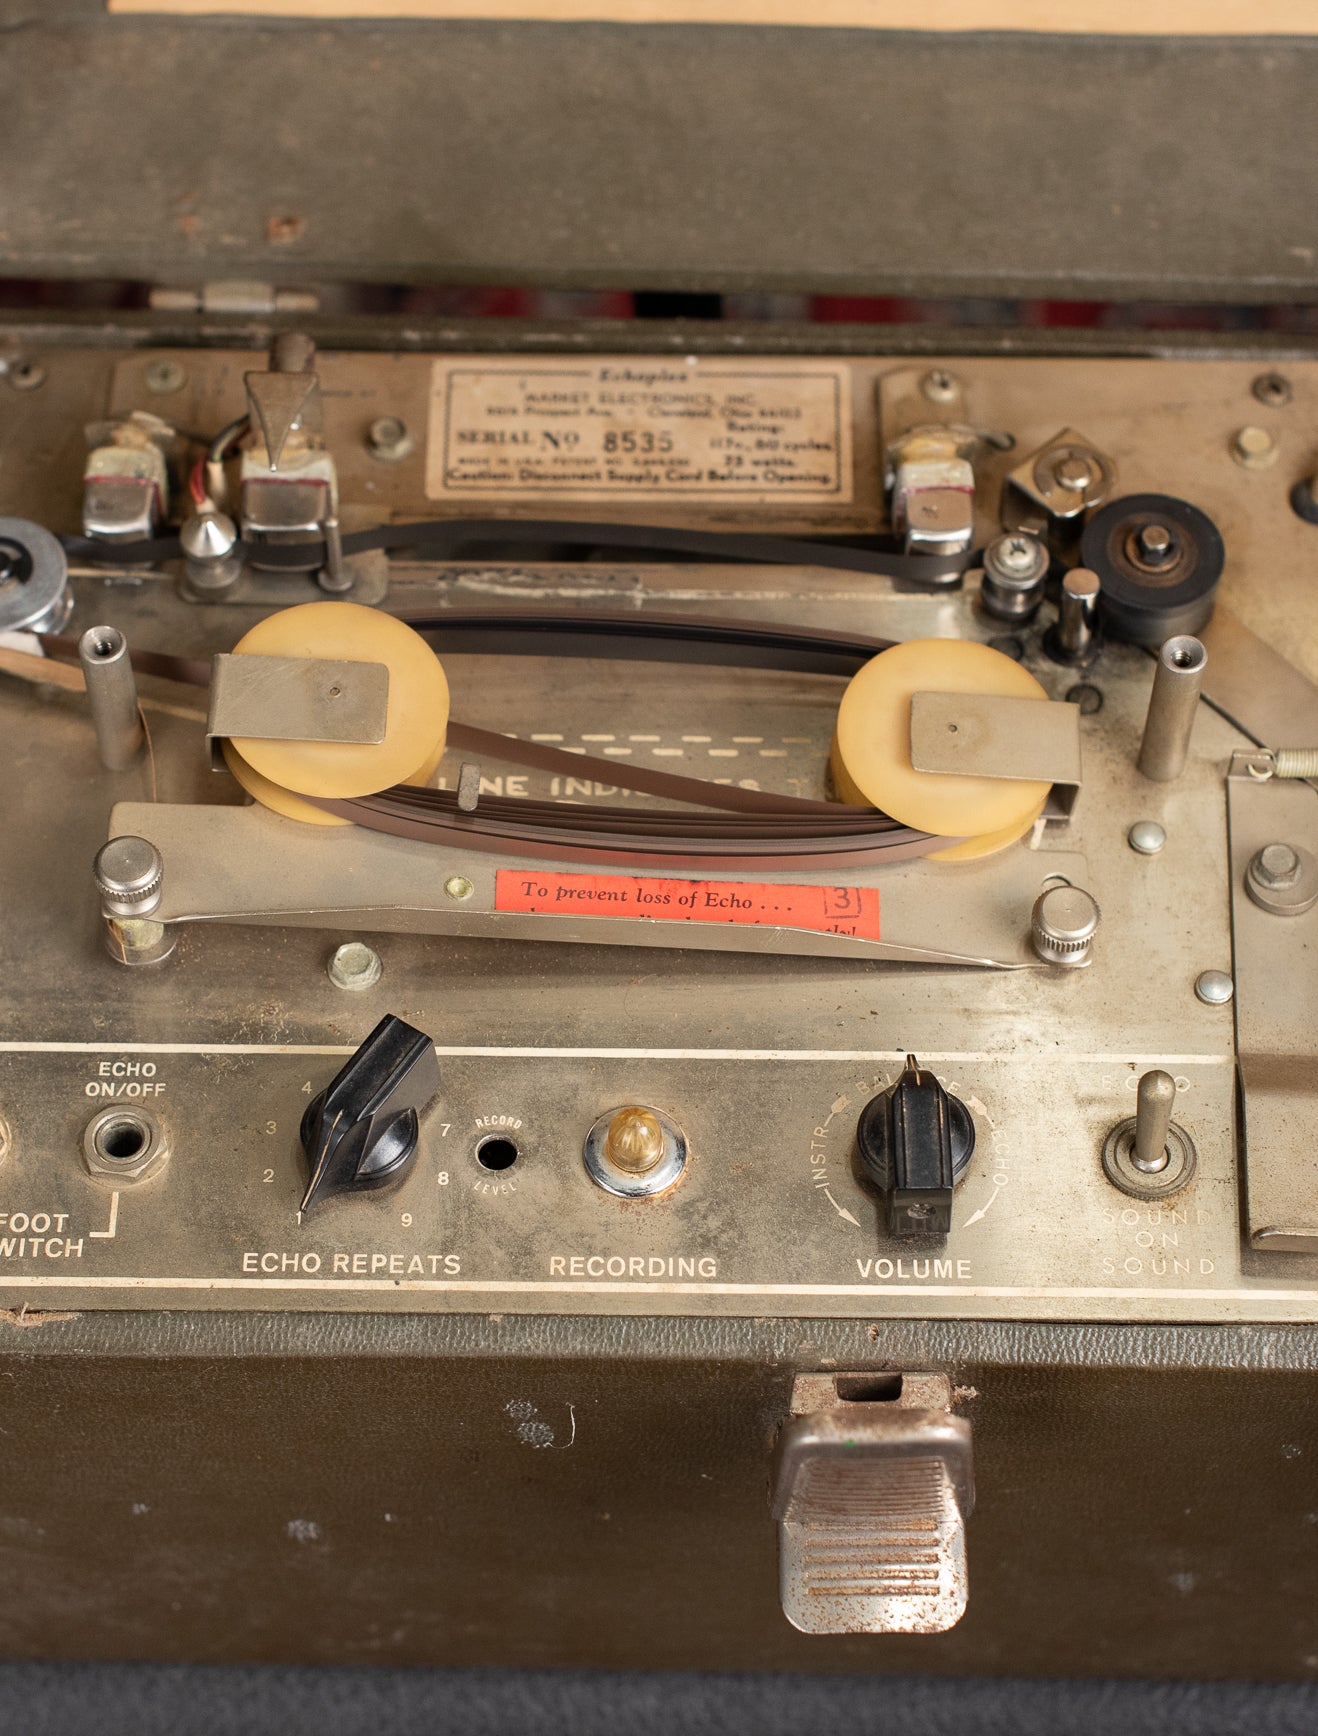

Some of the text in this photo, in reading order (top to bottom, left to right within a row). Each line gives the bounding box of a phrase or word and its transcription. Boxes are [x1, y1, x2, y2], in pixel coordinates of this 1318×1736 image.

[457, 430, 534, 445] SERIAL
[602, 431, 674, 452] 8535
[437, 776, 530, 797] LNE
[521, 881, 549, 898] To
[556, 885, 628, 902] prevent
[636, 888, 671, 905] loss
[678, 890, 697, 909] of
[704, 892, 753, 909] Echo
[98, 1062, 157, 1077] ECHO
[85, 1082, 166, 1098] ON/OFF
[301, 1081, 313, 1095] 4
[1102, 1075, 1191, 1092] ECO
[265, 1120, 277, 1135] 3
[440, 1123, 451, 1137] 7
[475, 1115, 523, 1130] RECORD
[810, 1126, 830, 1189] INSTR
[991, 1130, 1011, 1187] ECHO
[262, 1168, 274, 1183] 2
[437, 1171, 449, 1186] 8
[473, 1181, 518, 1196] LEVEL
[295, 1211, 302, 1225] 1
[401, 1212, 413, 1226] 9
[1102, 1208, 1211, 1225] SOUND
[1135, 1231, 1179, 1248] ON
[243, 1252, 461, 1275] ECHO REPEATS
[550, 1256, 718, 1278] RECORDING
[856, 1258, 973, 1279] VOLUME
[1102, 1257, 1214, 1275] SOUND
